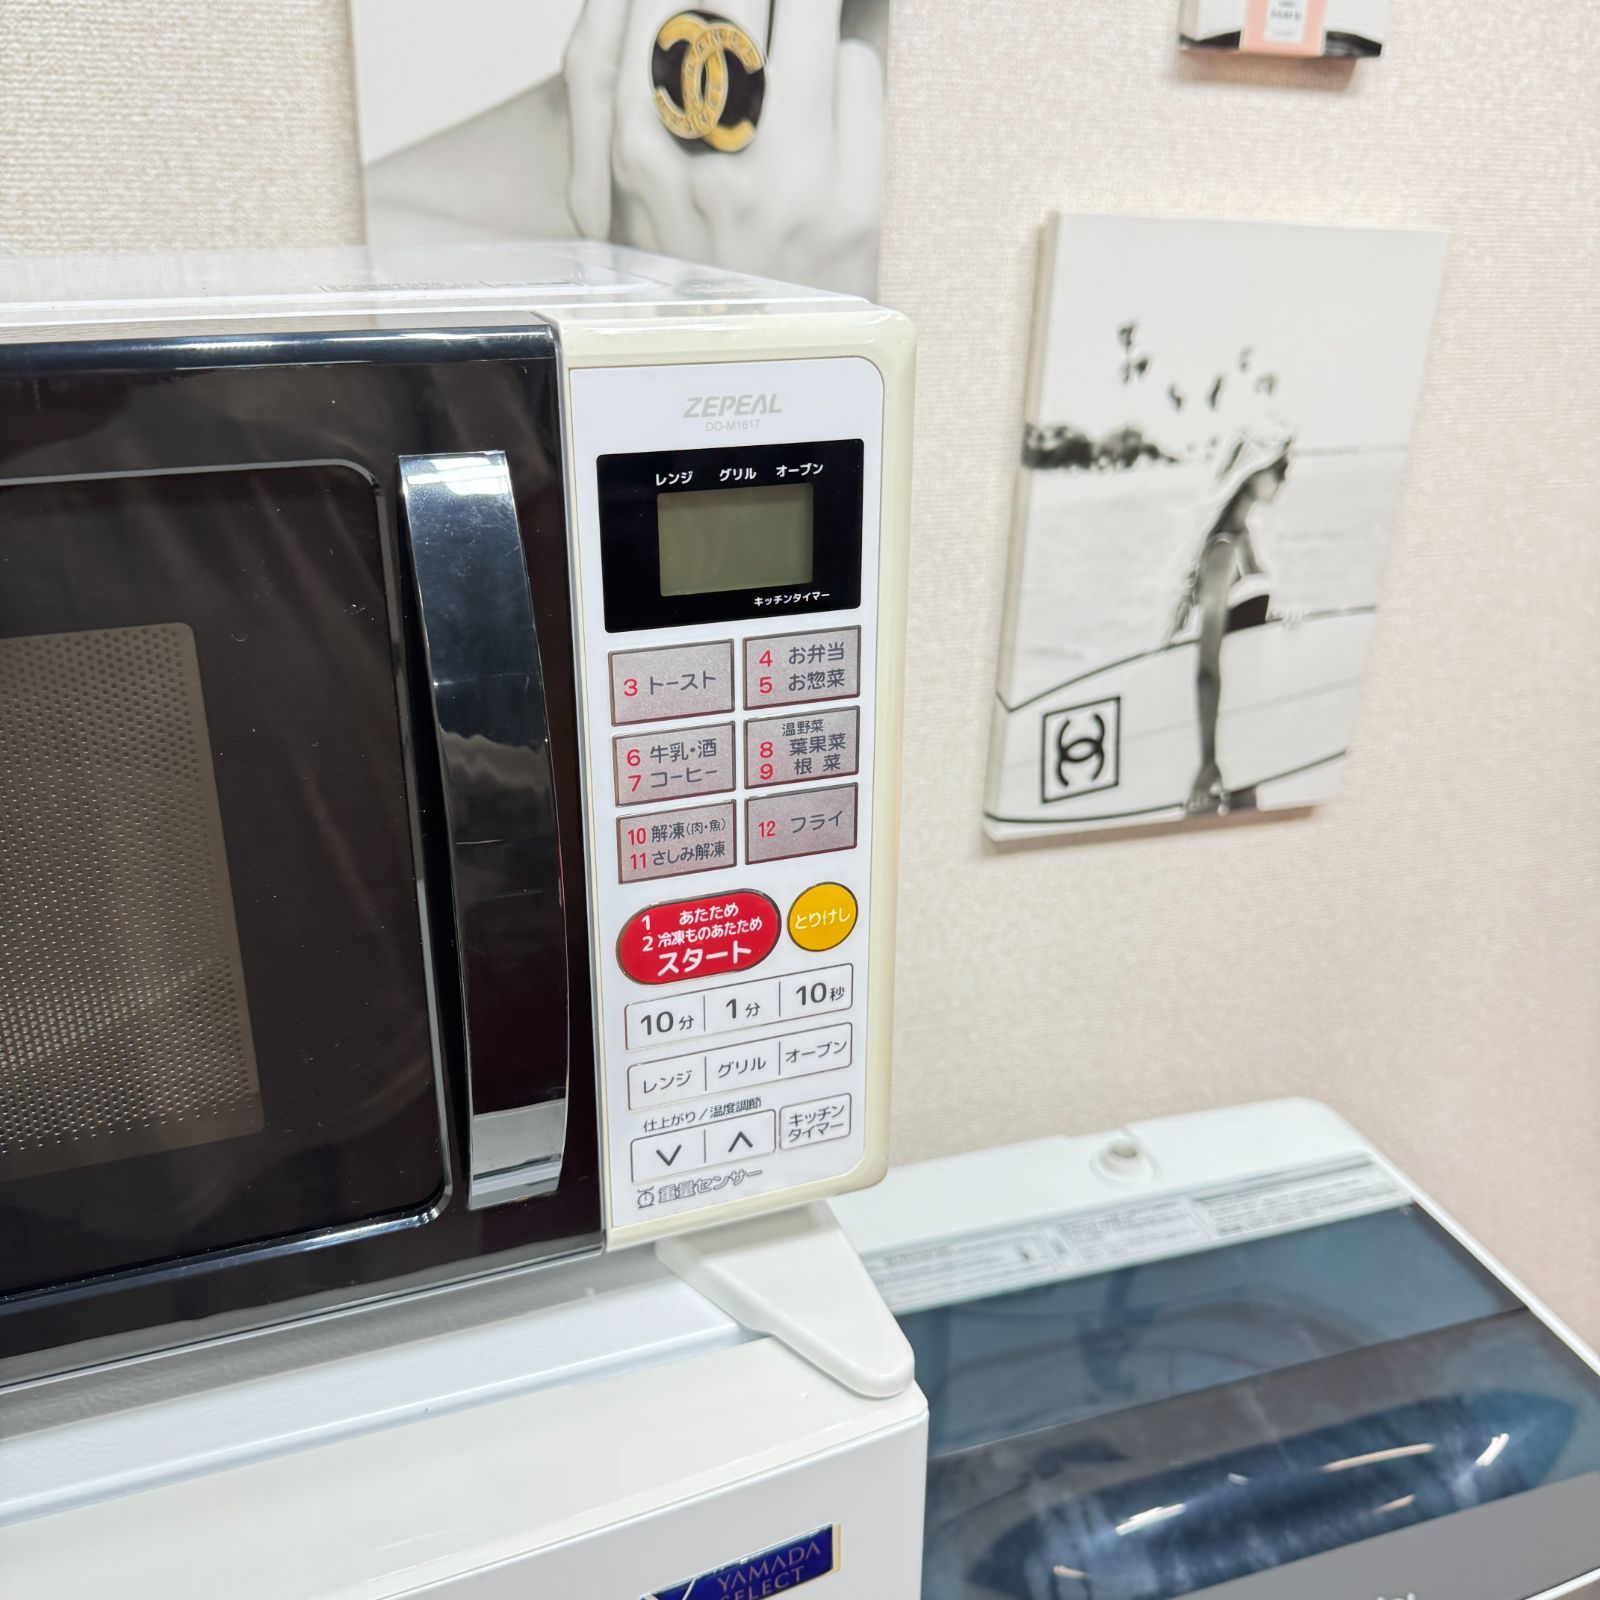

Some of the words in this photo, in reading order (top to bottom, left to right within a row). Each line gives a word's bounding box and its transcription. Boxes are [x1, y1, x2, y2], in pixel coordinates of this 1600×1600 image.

[683, 393, 783, 418] ZEPEAL
[705, 419, 761, 432] DO-M1617
[655, 470, 694, 486] レンジ
[719, 467, 757, 482] グリル
[776, 462, 824, 478] オーブン
[754, 591, 831, 607] キッチンタイマー
[758, 649, 773, 668] 4
[788, 642, 845, 665] お弁当
[623, 678, 639, 697] 3
[650, 670, 717, 695] トースト
[759, 676, 773, 694] 5
[788, 668, 846, 692] お惣菜
[781, 719, 825, 737] 温野菜
[626, 748, 641, 767] 6
[649, 737, 718, 765] 牛乳・酒
[759, 741, 774, 759] 8
[788, 732, 847, 757] 葉果菜
[627, 774, 642, 793] 7
[650, 767, 719, 789] コーヒー
[759, 763, 774, 781] 9
[627, 827, 647, 846] 10
[758, 820, 777, 838] 12
[791, 810, 843, 834] フライ
[630, 852, 648, 870] 11
[651, 840, 726, 867] さしみ解凍
[641, 914, 651, 931] 1
[679, 902, 740, 926] あたため
[794, 907, 851, 930] とりけし
[642, 936, 654, 952] 2
[657, 916, 763, 949] 冷凍ものあたため
[657, 939, 752, 977] スタート
[785, 1041, 848, 1064] オーブン
[717, 1056, 767, 1078] グリル
[642, 1069, 692, 1094] レンジ
[788, 1105, 845, 1127] キッチン
[788, 1122, 844, 1144] タイマー
[658, 1168, 764, 1204] 重量センサー
[717, 1541, 821, 1592] YAMADA
